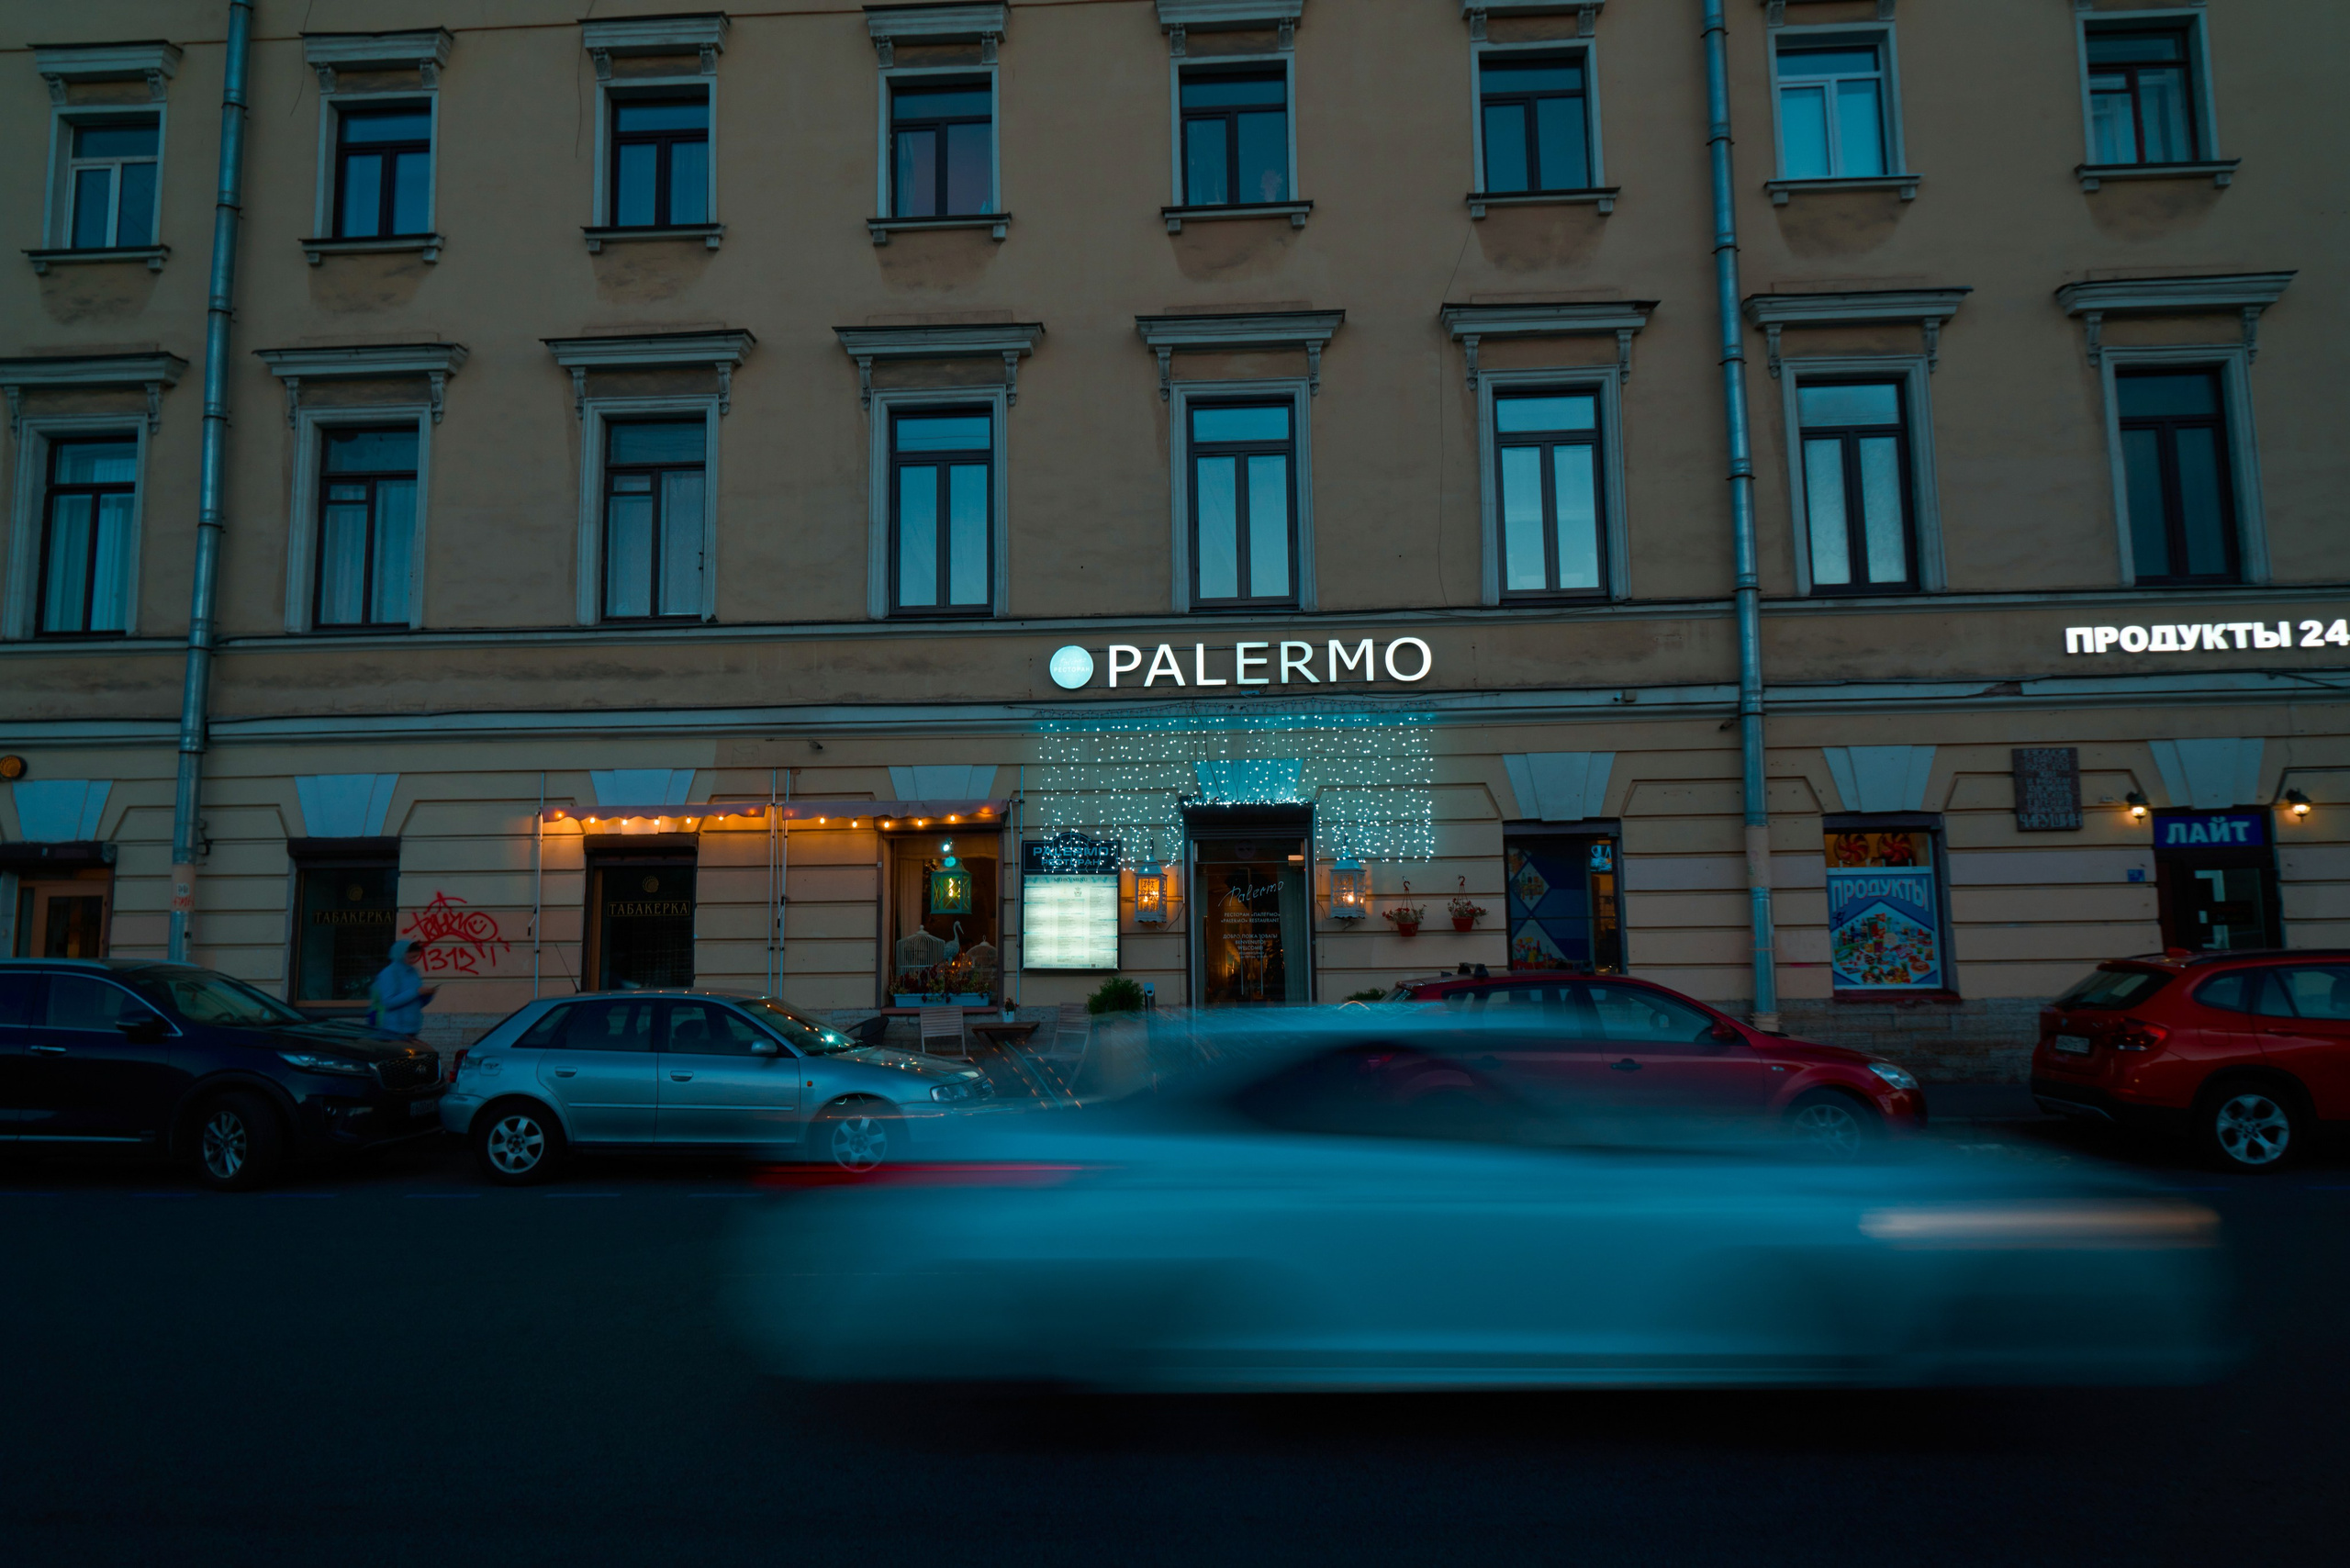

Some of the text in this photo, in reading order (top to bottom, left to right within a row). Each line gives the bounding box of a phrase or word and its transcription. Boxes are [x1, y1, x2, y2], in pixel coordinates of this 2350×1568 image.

[2065, 619, 2350, 654] ПРОДУКТЫ 24
[1108, 637, 1432, 688] PALERMO
[2019, 813, 2083, 827] ЧАРУШИН
[2165, 816, 2251, 845] ЛАЙТ
[1033, 846, 1109, 857] PALERMO
[1041, 858, 1101, 867] РЕСТОРАН
[1217, 881, 1284, 907] Palermo
[1830, 879, 1930, 912] ПРОДУКТЫ
[315, 911, 392, 924] ТАБАКЕРКА
[610, 902, 688, 915] ТАБАКЕРКА
[418, 946, 479, 974] 1312
